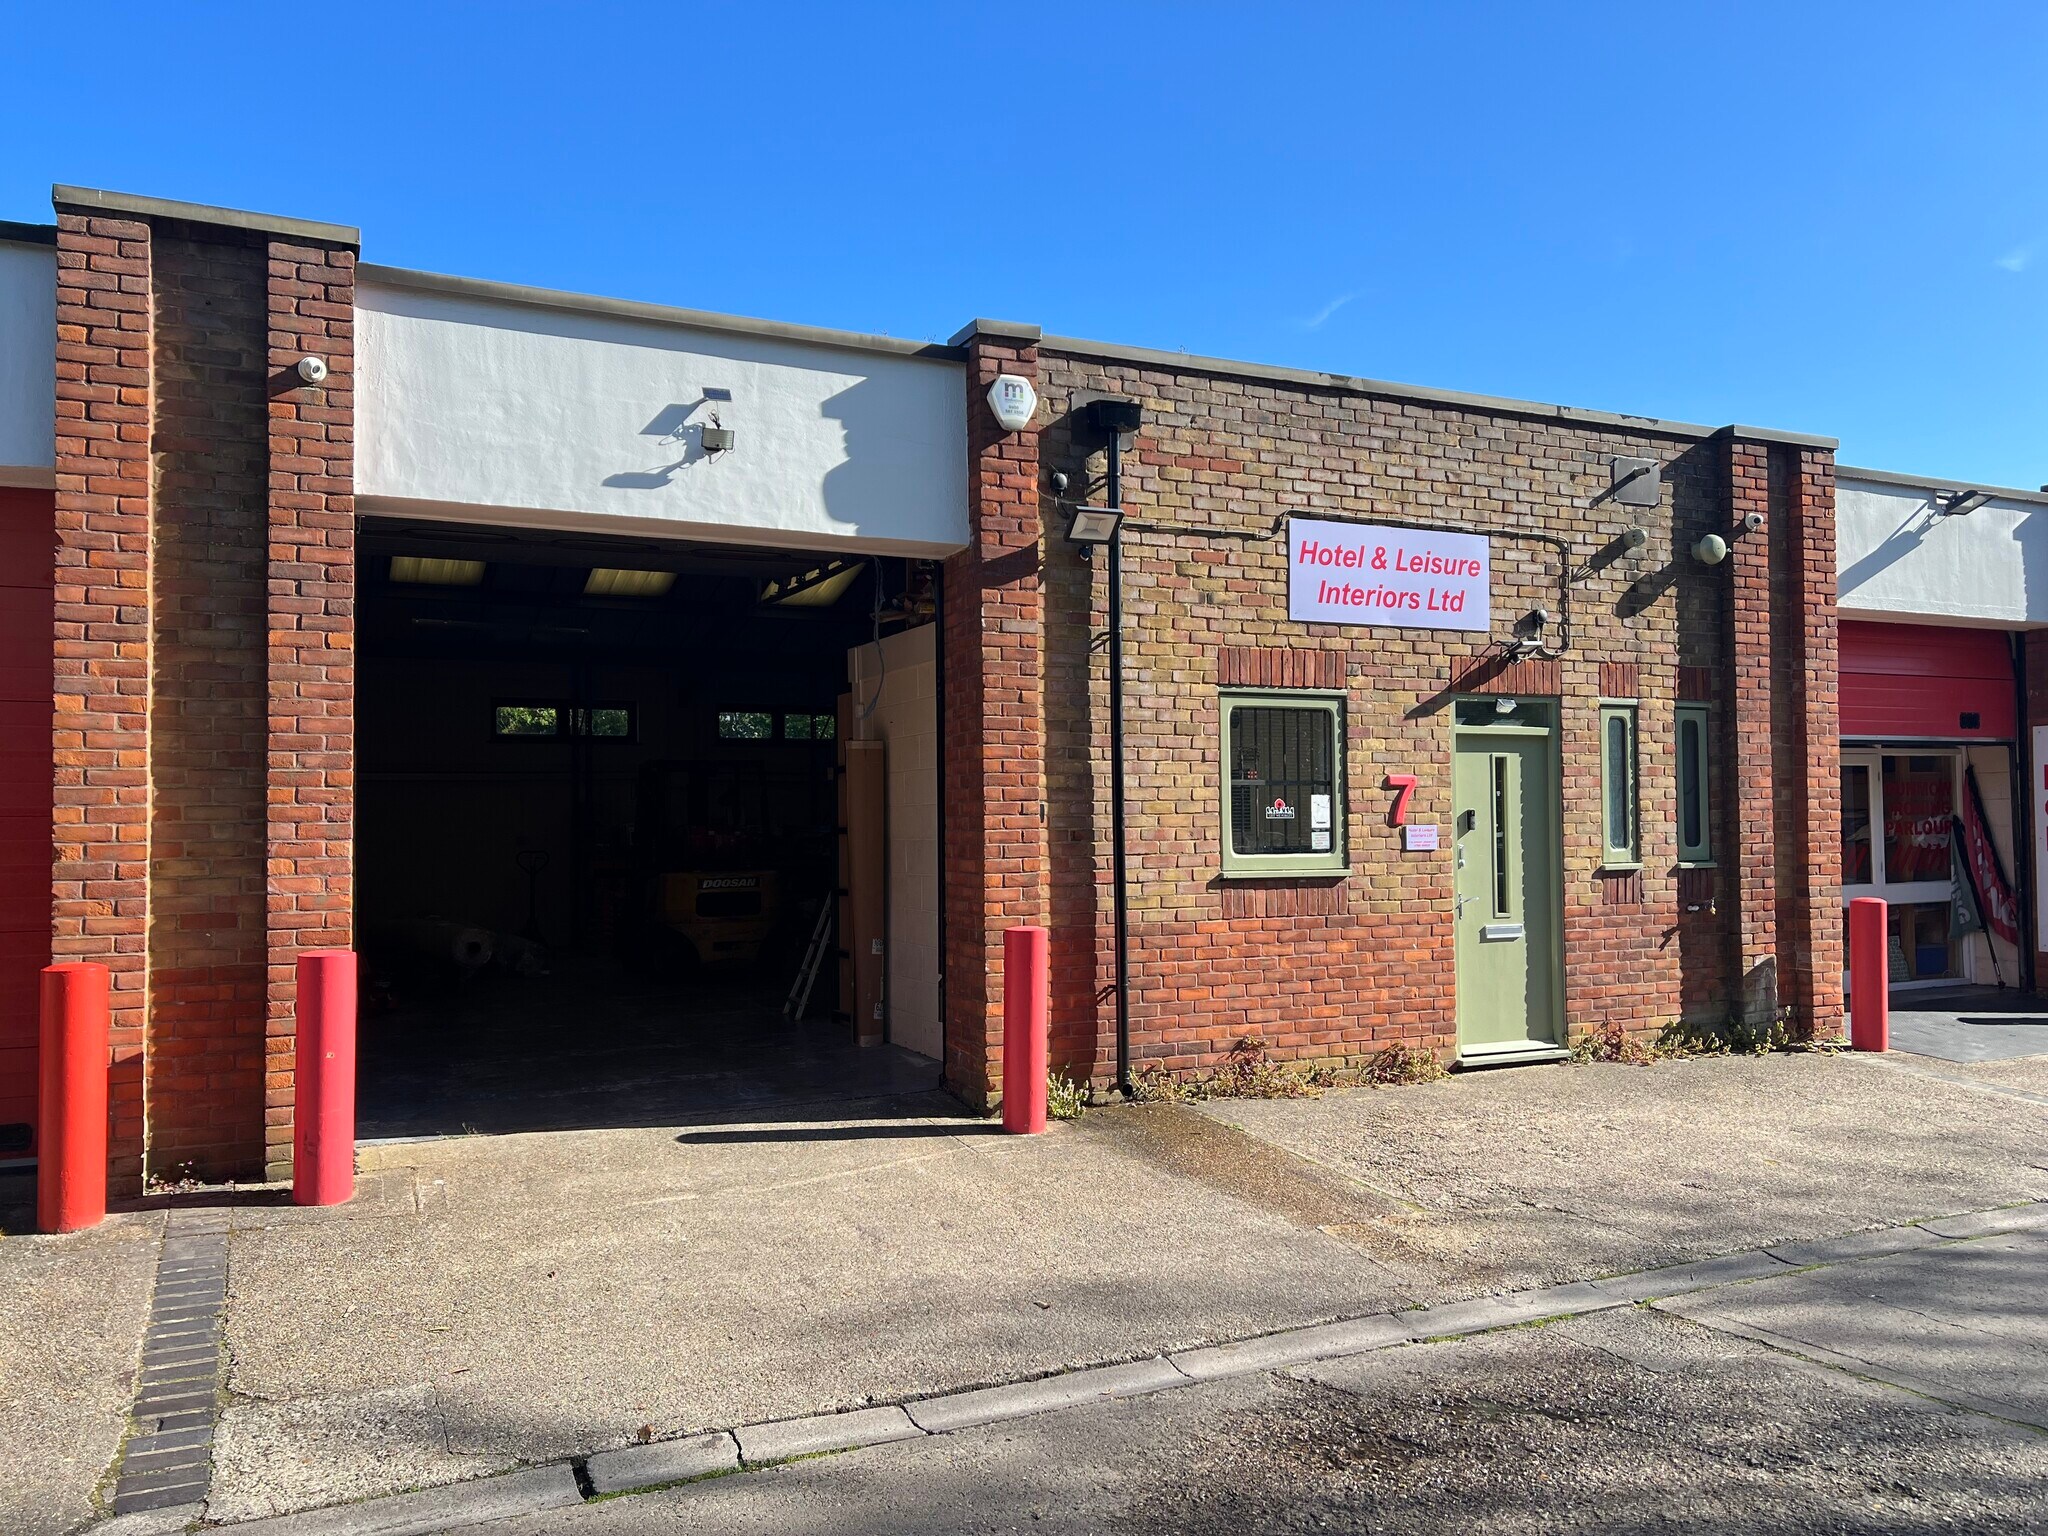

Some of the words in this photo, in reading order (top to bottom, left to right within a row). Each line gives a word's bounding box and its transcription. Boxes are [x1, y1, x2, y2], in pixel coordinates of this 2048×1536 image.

[1298, 540, 1365, 568] Hotel
[1370, 546, 1388, 570] &
[1395, 548, 1481, 577] Leisure
[1318, 580, 1421, 610] Interiors
[1427, 587, 1466, 613] Ltd
[1388, 774, 1417, 824] 7
[1885, 820, 1952, 835] PARLOUR
[702, 878, 756, 888] DOOSAN
